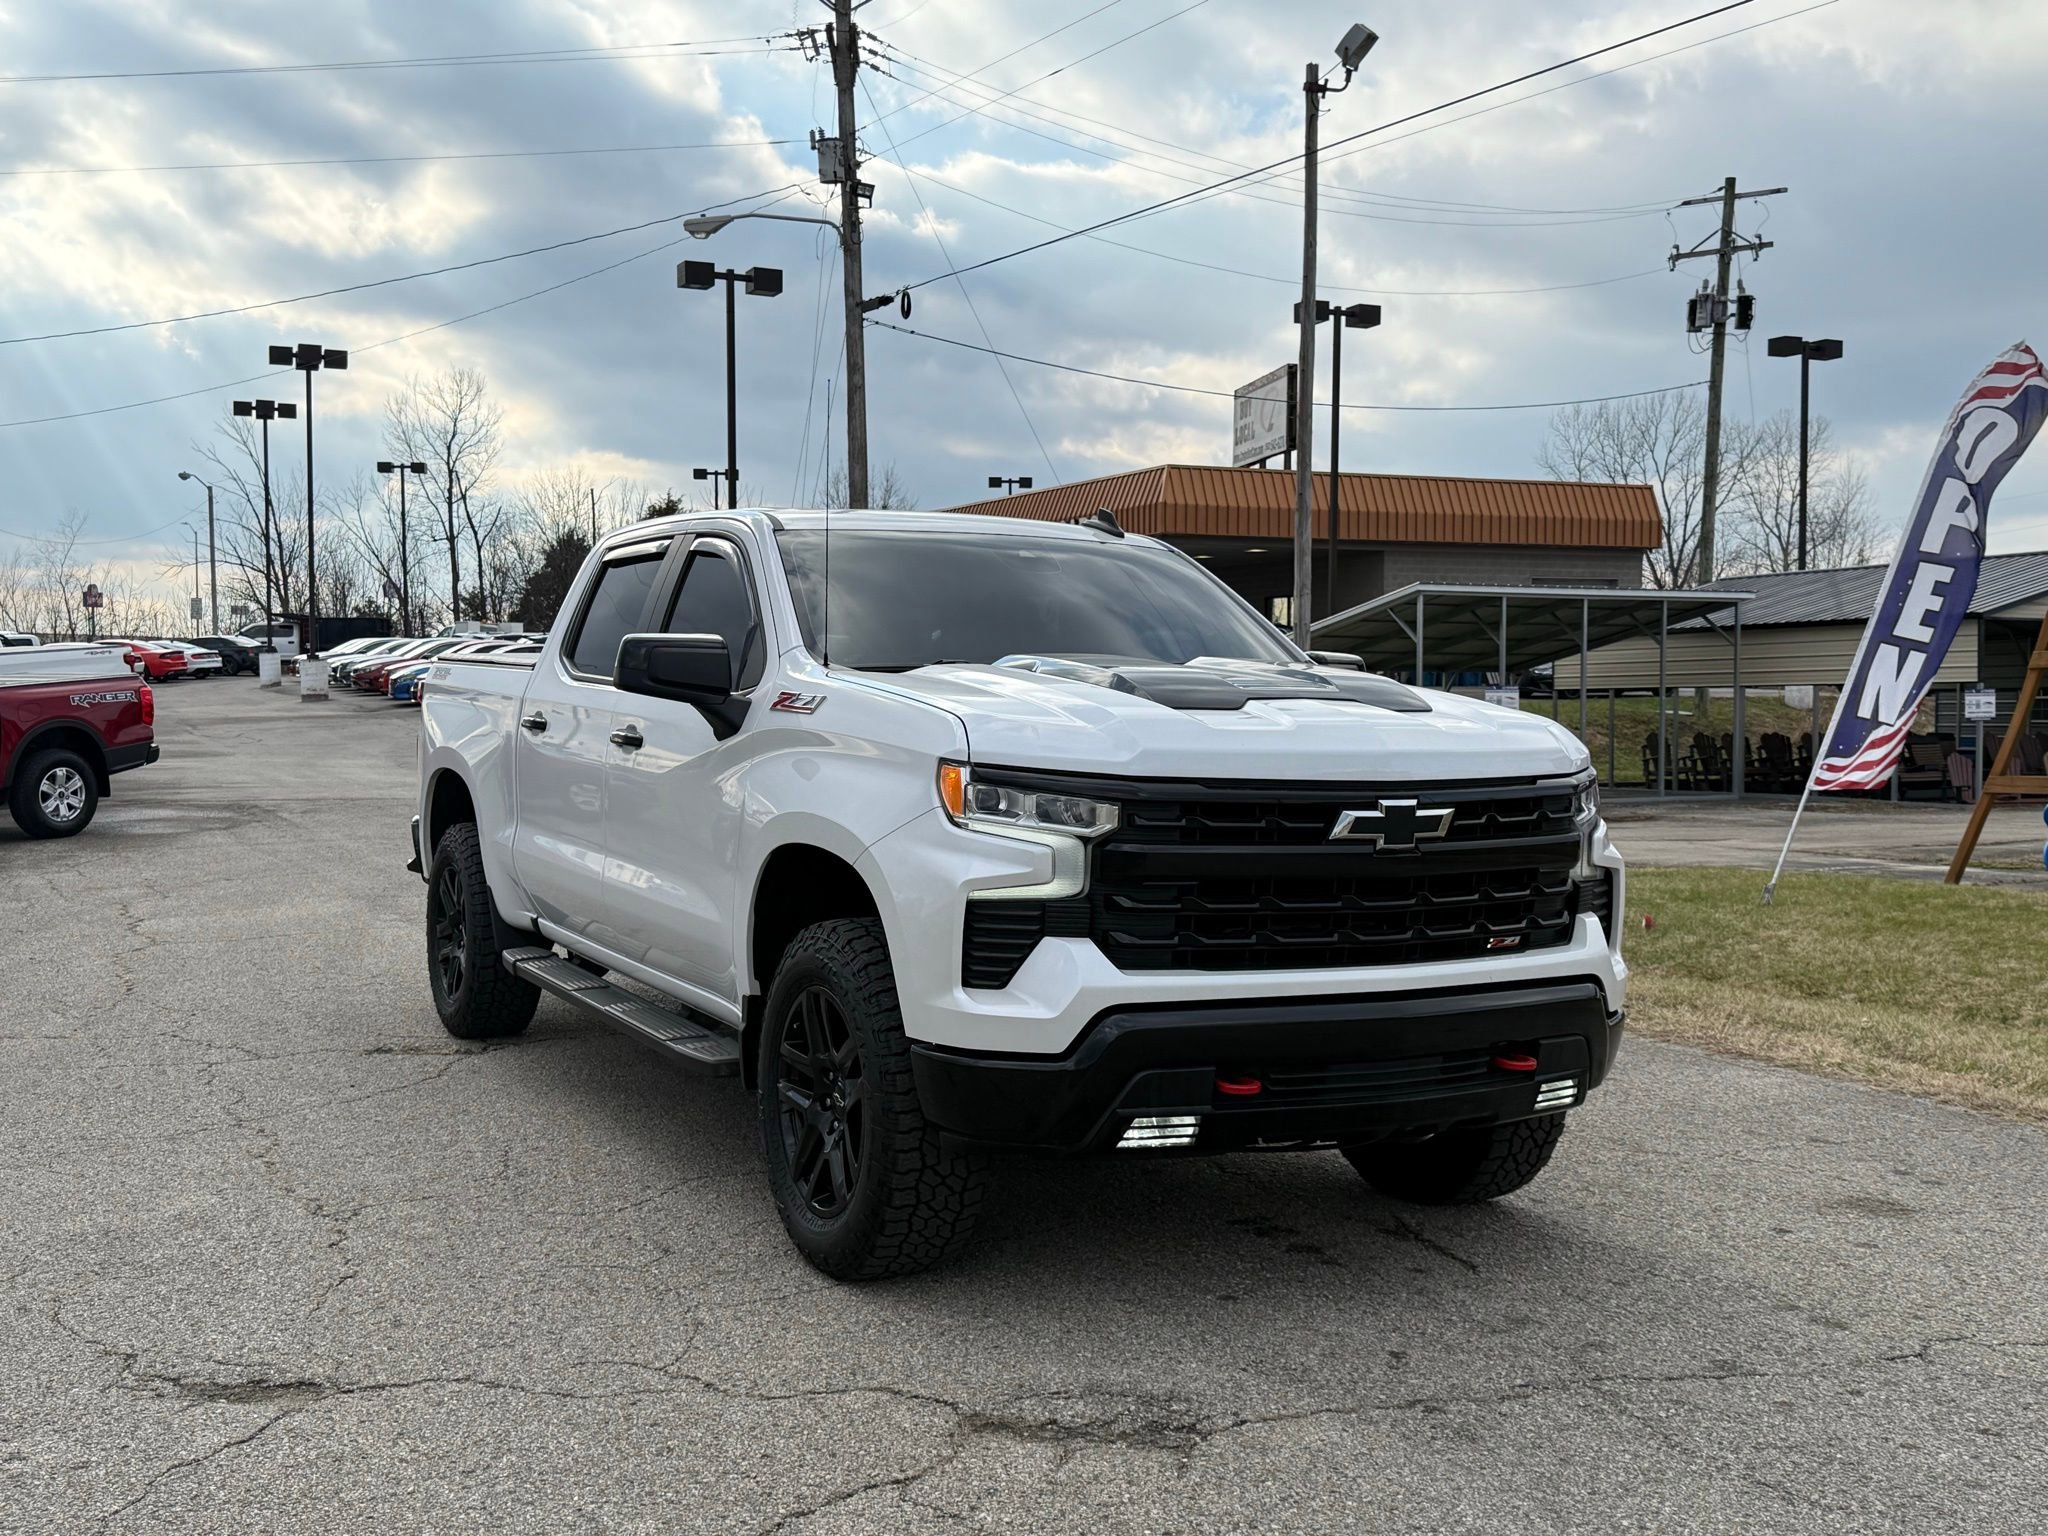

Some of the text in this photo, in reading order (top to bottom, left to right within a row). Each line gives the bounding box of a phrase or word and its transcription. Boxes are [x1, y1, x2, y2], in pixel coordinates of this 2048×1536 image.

[1857, 405, 2019, 727] OPEN
[70, 690, 139, 708] RANGER
[769, 689, 828, 715] Z71
